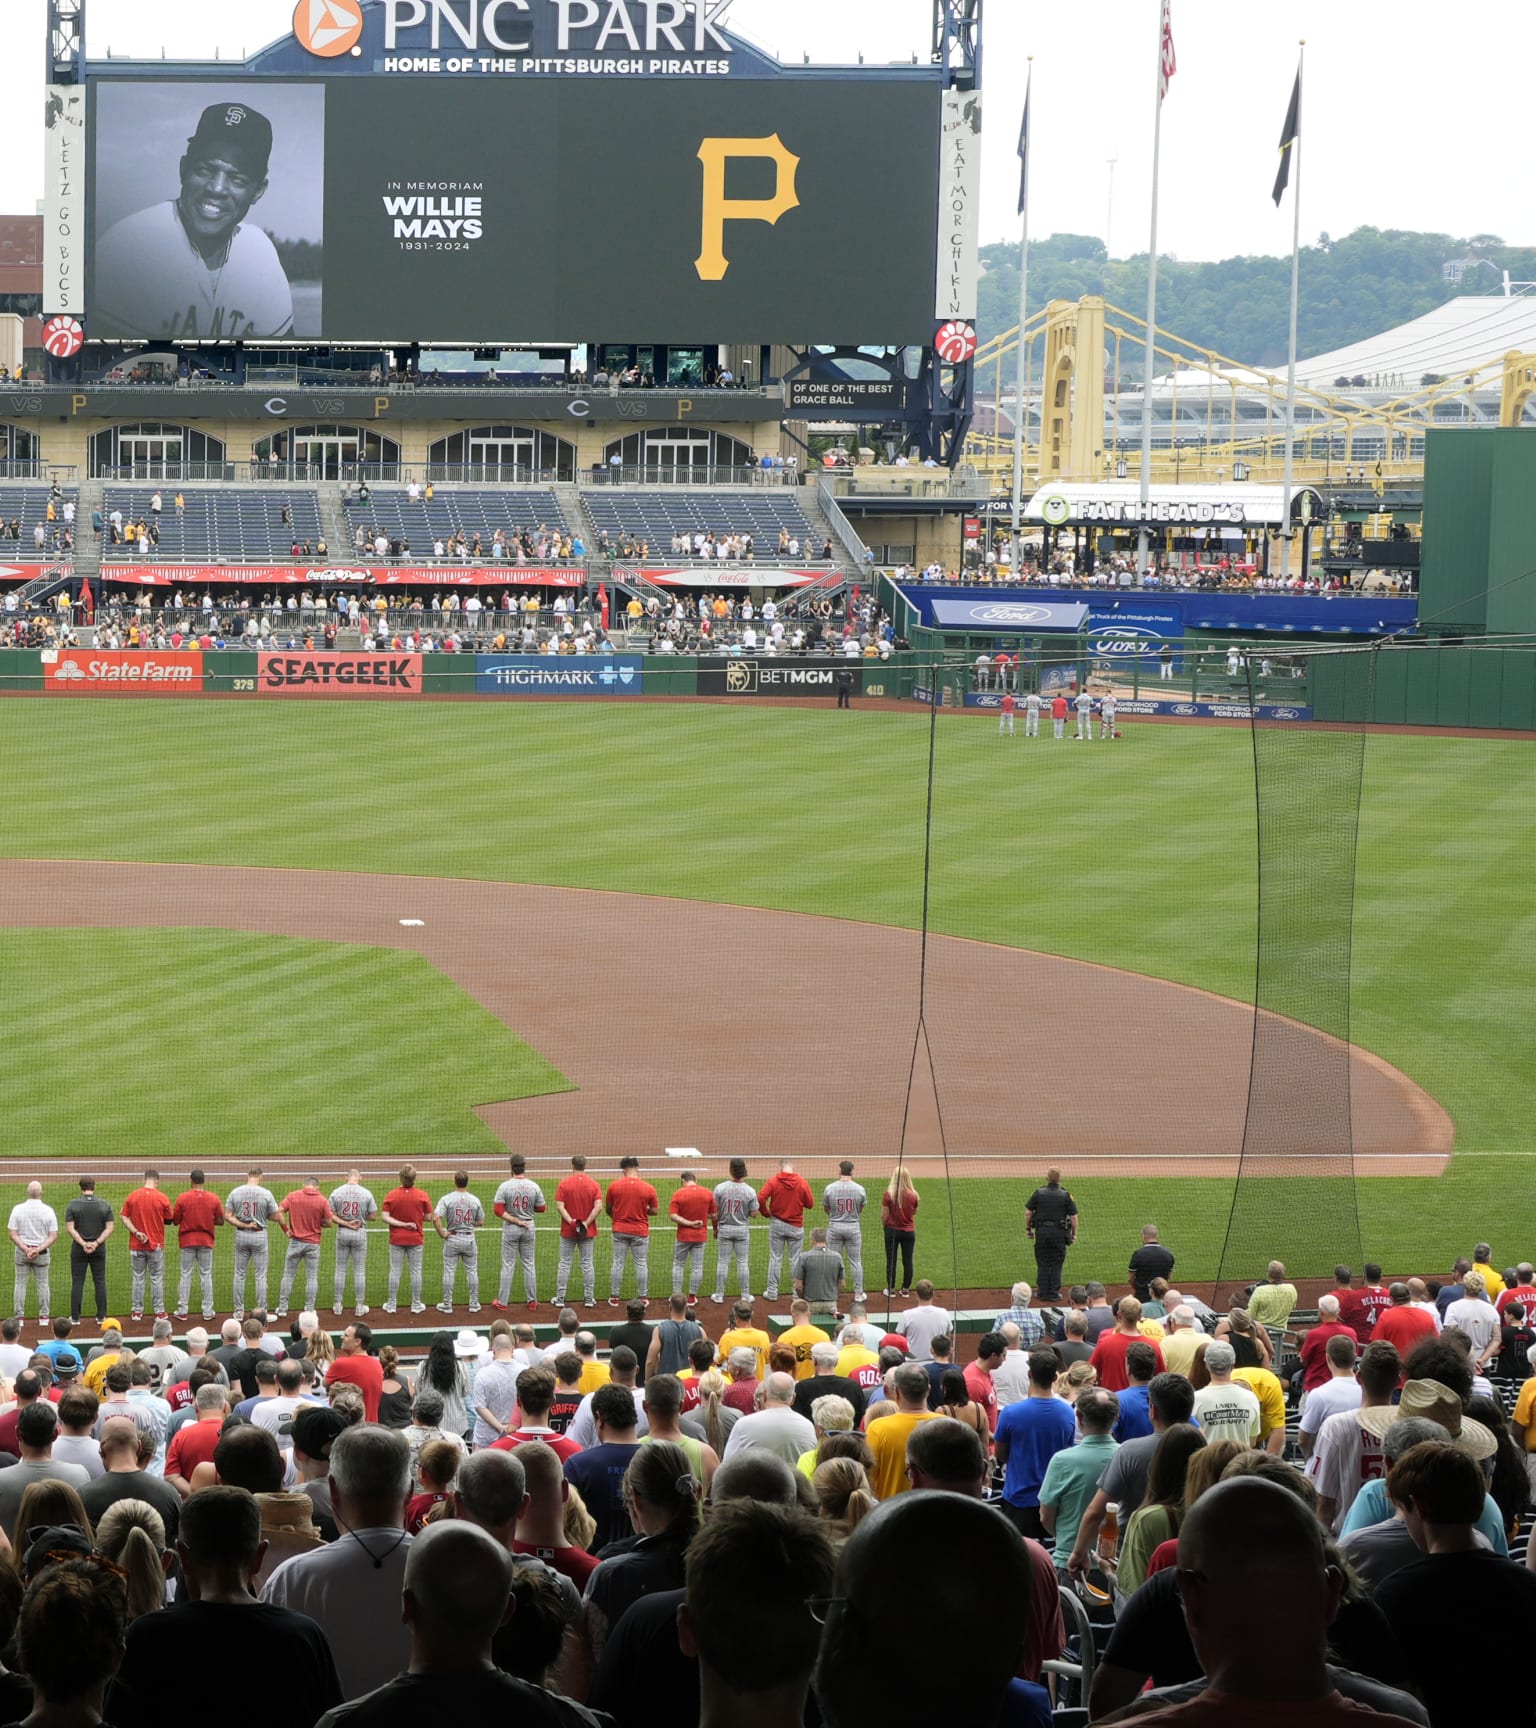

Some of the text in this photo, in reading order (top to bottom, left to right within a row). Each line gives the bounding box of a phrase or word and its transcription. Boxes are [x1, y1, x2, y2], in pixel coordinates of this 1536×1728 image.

[383, 0, 734, 52] PNC PARK
[384, 58, 730, 75] HOME OF THE PITTSBURGH PIRATES
[60, 136, 72, 197] LETZ
[953, 138, 966, 179] EAT
[387, 182, 484, 191] IN MEMORIAM
[383, 196, 482, 216] WILLIE
[695, 131, 802, 281] P
[950, 185, 967, 227] MOR
[58, 206, 71, 237] GO
[393, 219, 483, 239] MAYS
[400, 242, 470, 250] 1931-2024
[58, 246, 71, 308] BUCS
[949, 233, 964, 314] CHIKIN
[793, 384, 894, 394] OF ONE OF THE BEST
[793, 395, 854, 405] GRACE BALL
[1076, 500, 1127, 521] FAT
[982, 605, 1037, 620] Ford
[265, 658, 413, 689] SEATGEEK
[760, 670, 833, 684] BETMGM
[242, 1201, 257, 1217] 31
[342, 1200, 359, 1216] 28
[512, 1195, 529, 1210] 46
[837, 1198, 854, 1213] 50
[455, 1208, 472, 1224] 54
